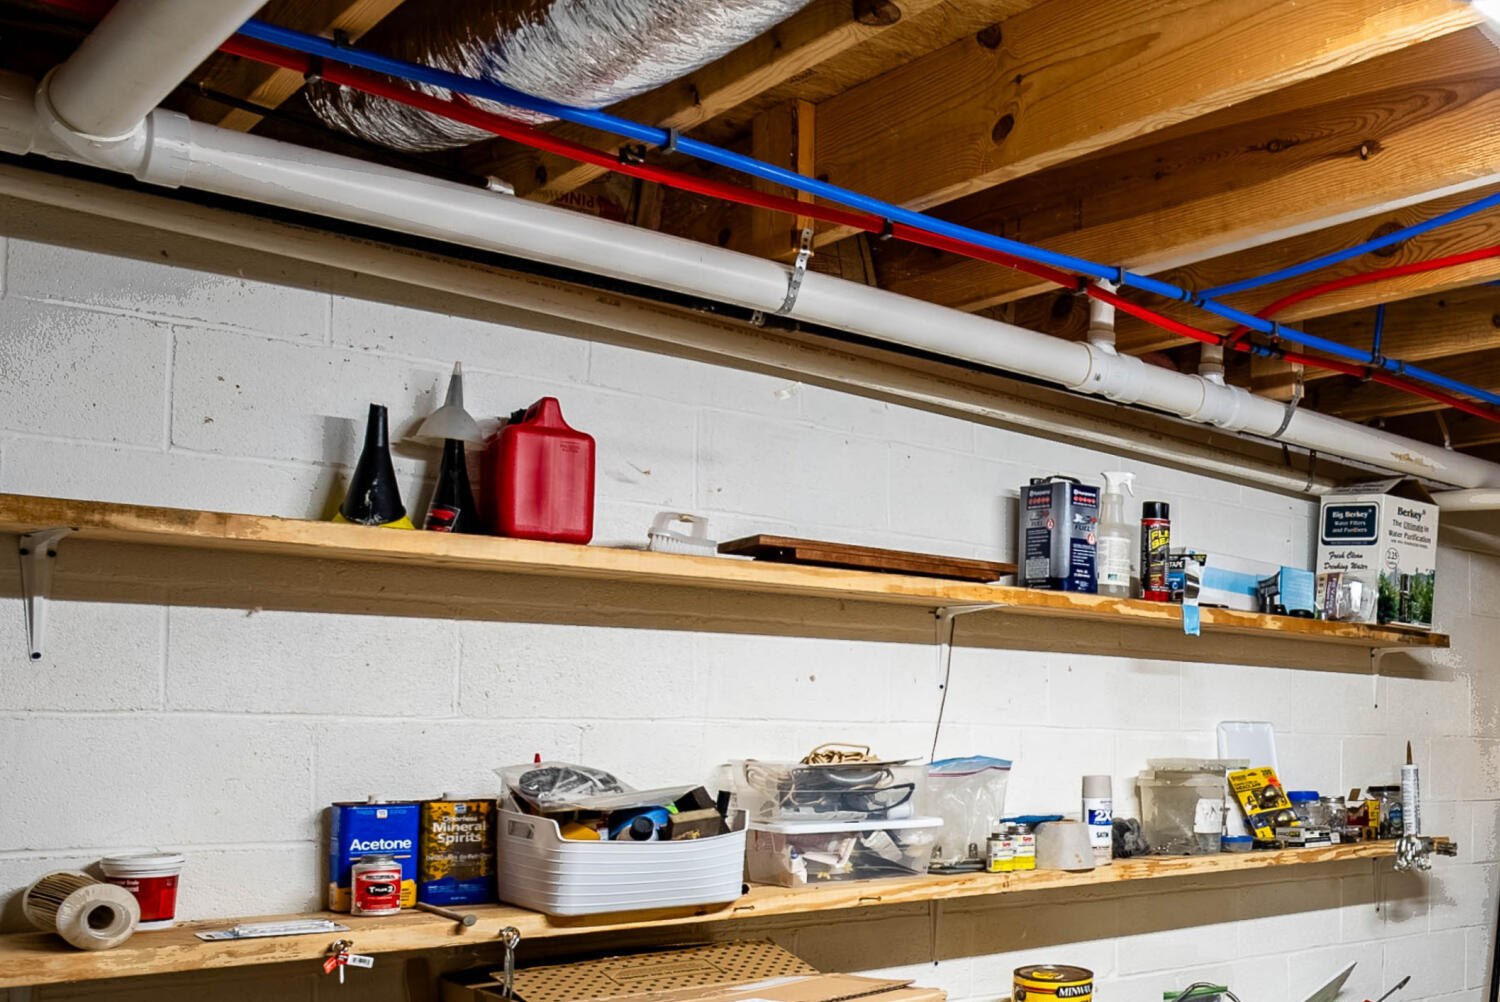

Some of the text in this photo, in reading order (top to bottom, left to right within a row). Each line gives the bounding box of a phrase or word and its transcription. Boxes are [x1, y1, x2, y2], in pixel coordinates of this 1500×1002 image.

[1332, 511, 1369, 519] Big Berkey
[1392, 519, 1402, 527] The
[1094, 809, 1112, 821] 2X
[433, 821, 486, 833] Mineral
[349, 838, 412, 851] Acetone
[437, 833, 482, 846] Spirits
[1058, 984, 1092, 997] MINWA
